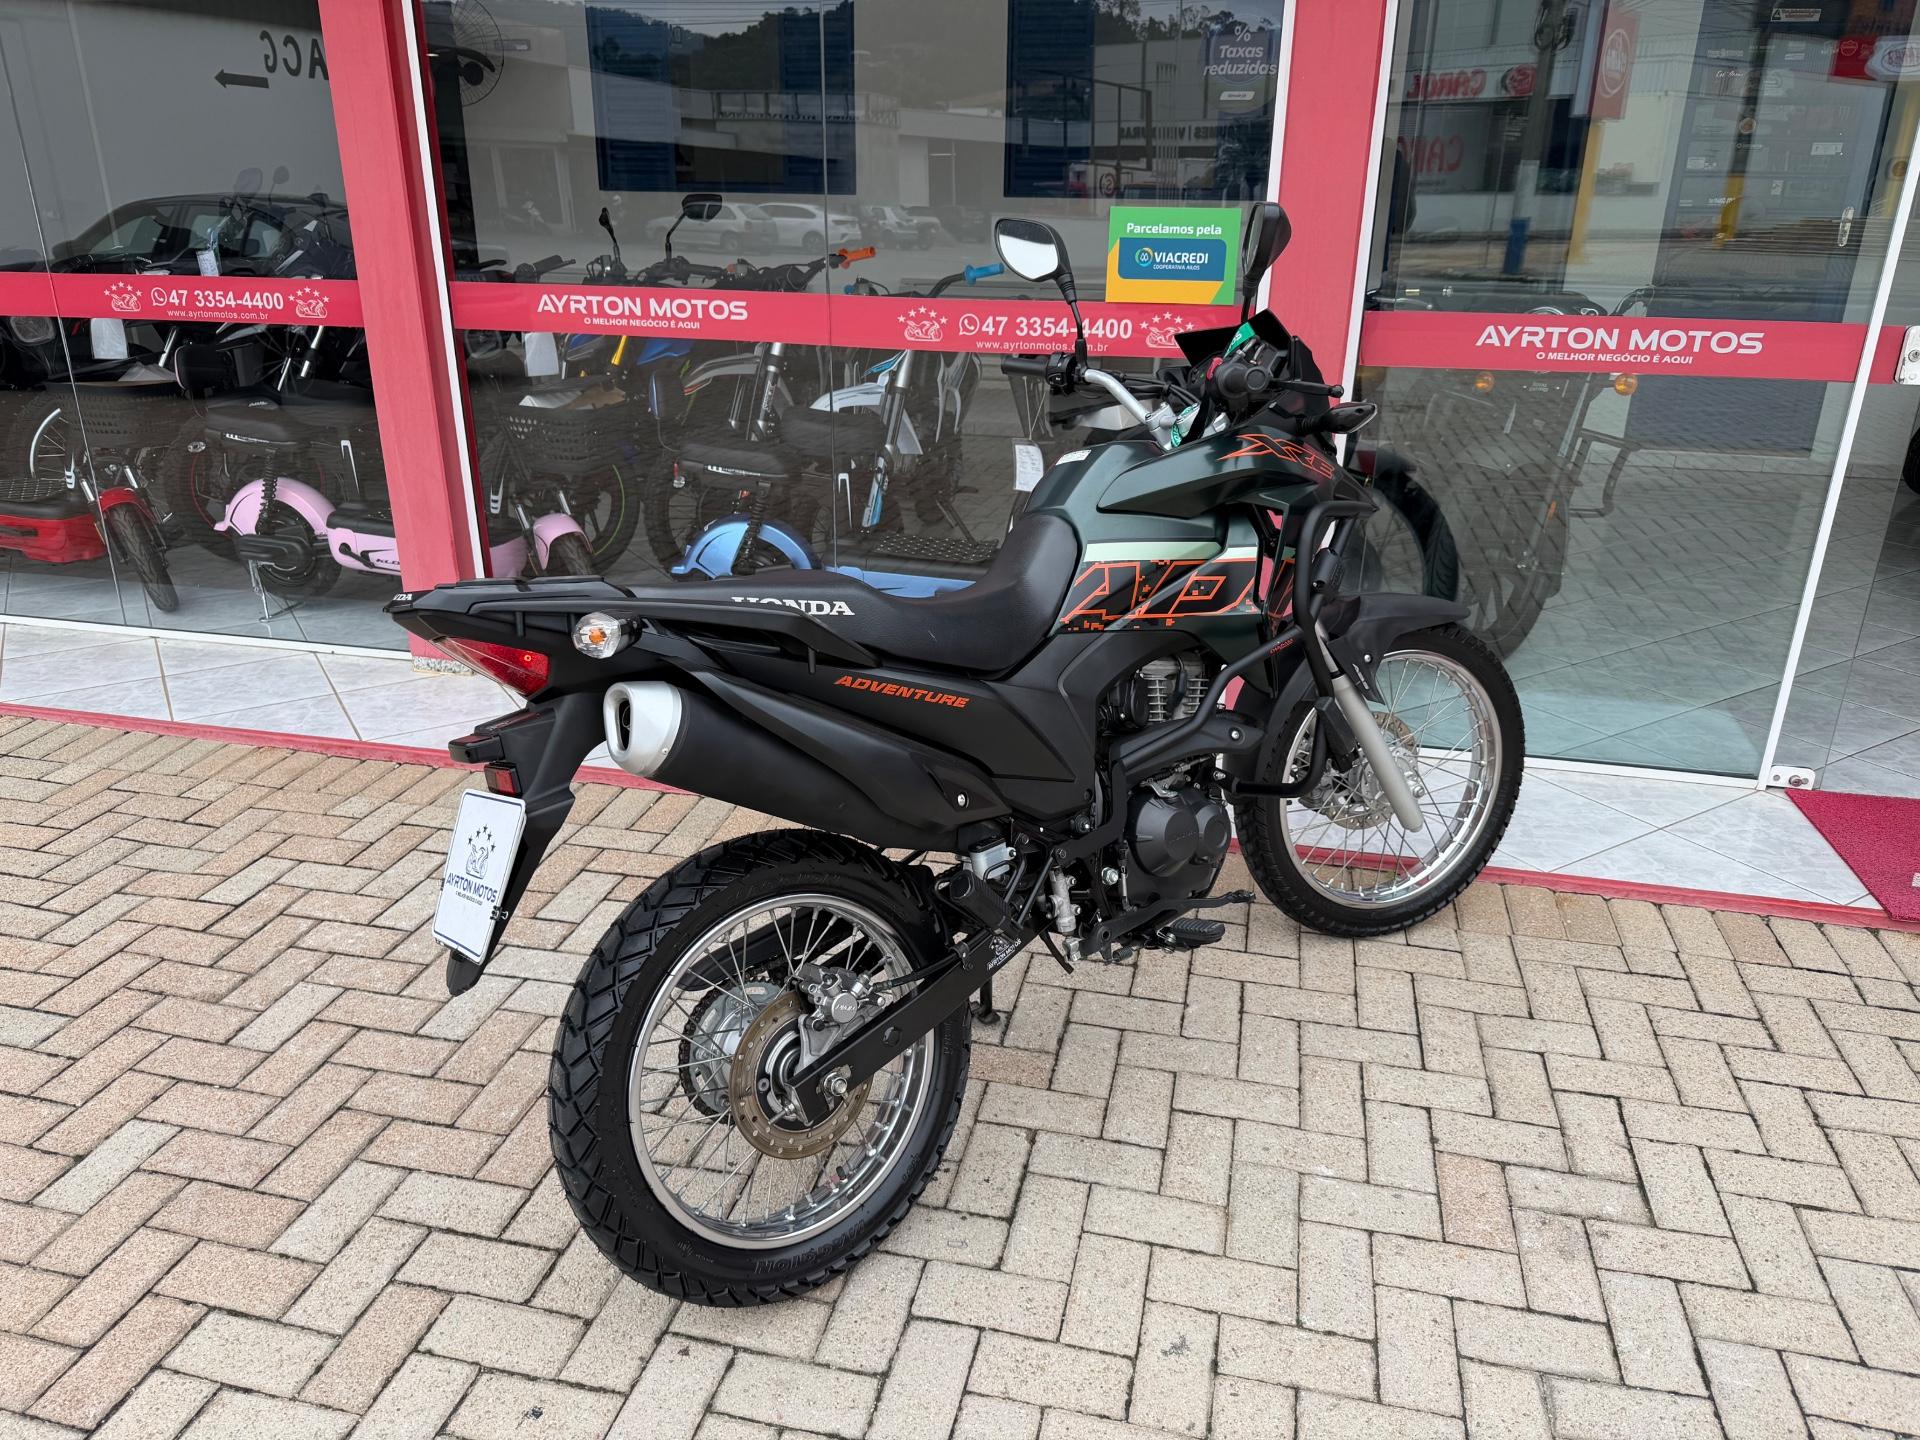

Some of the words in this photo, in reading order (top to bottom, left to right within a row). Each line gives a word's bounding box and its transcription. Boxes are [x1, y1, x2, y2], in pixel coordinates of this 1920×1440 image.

[1220, 45, 1264, 58] Taxas
[1203, 60, 1278, 76] reduzidas
[1126, 222, 1194, 235] Parcelamos
[1196, 224, 1223, 237] pela
[1154, 251, 1209, 265] VIACREDI
[168, 289, 188, 307] 47
[194, 289, 285, 310] 3354-4400
[537, 293, 642, 317] AYRTON
[649, 297, 749, 321] MOTOS
[167, 308, 269, 320] www.ayrtonmotos.com.br
[584, 317, 592, 325] O
[592, 318, 628, 327] MELHOR
[629, 317, 669, 329] NEGÓCIO
[670, 318, 676, 329] É
[677, 320, 701, 330] AQUI
[981, 316, 1008, 336] 47
[1015, 316, 1133, 340] 3354-4400
[1475, 325, 1618, 351] AYRTON
[1628, 328, 1765, 355] MOTOS
[1536, 352, 1546, 360] O
[1547, 352, 1597, 362] MELHOR
[1598, 352, 1651, 363] NEGÓCIO
[1652, 352, 1661, 363] É
[1661, 355, 1694, 365] AQUI
[834, 675, 971, 708] ADVENTURE
[446, 872, 474, 894] AYRTON
[473, 883, 499, 904] MOTOS
